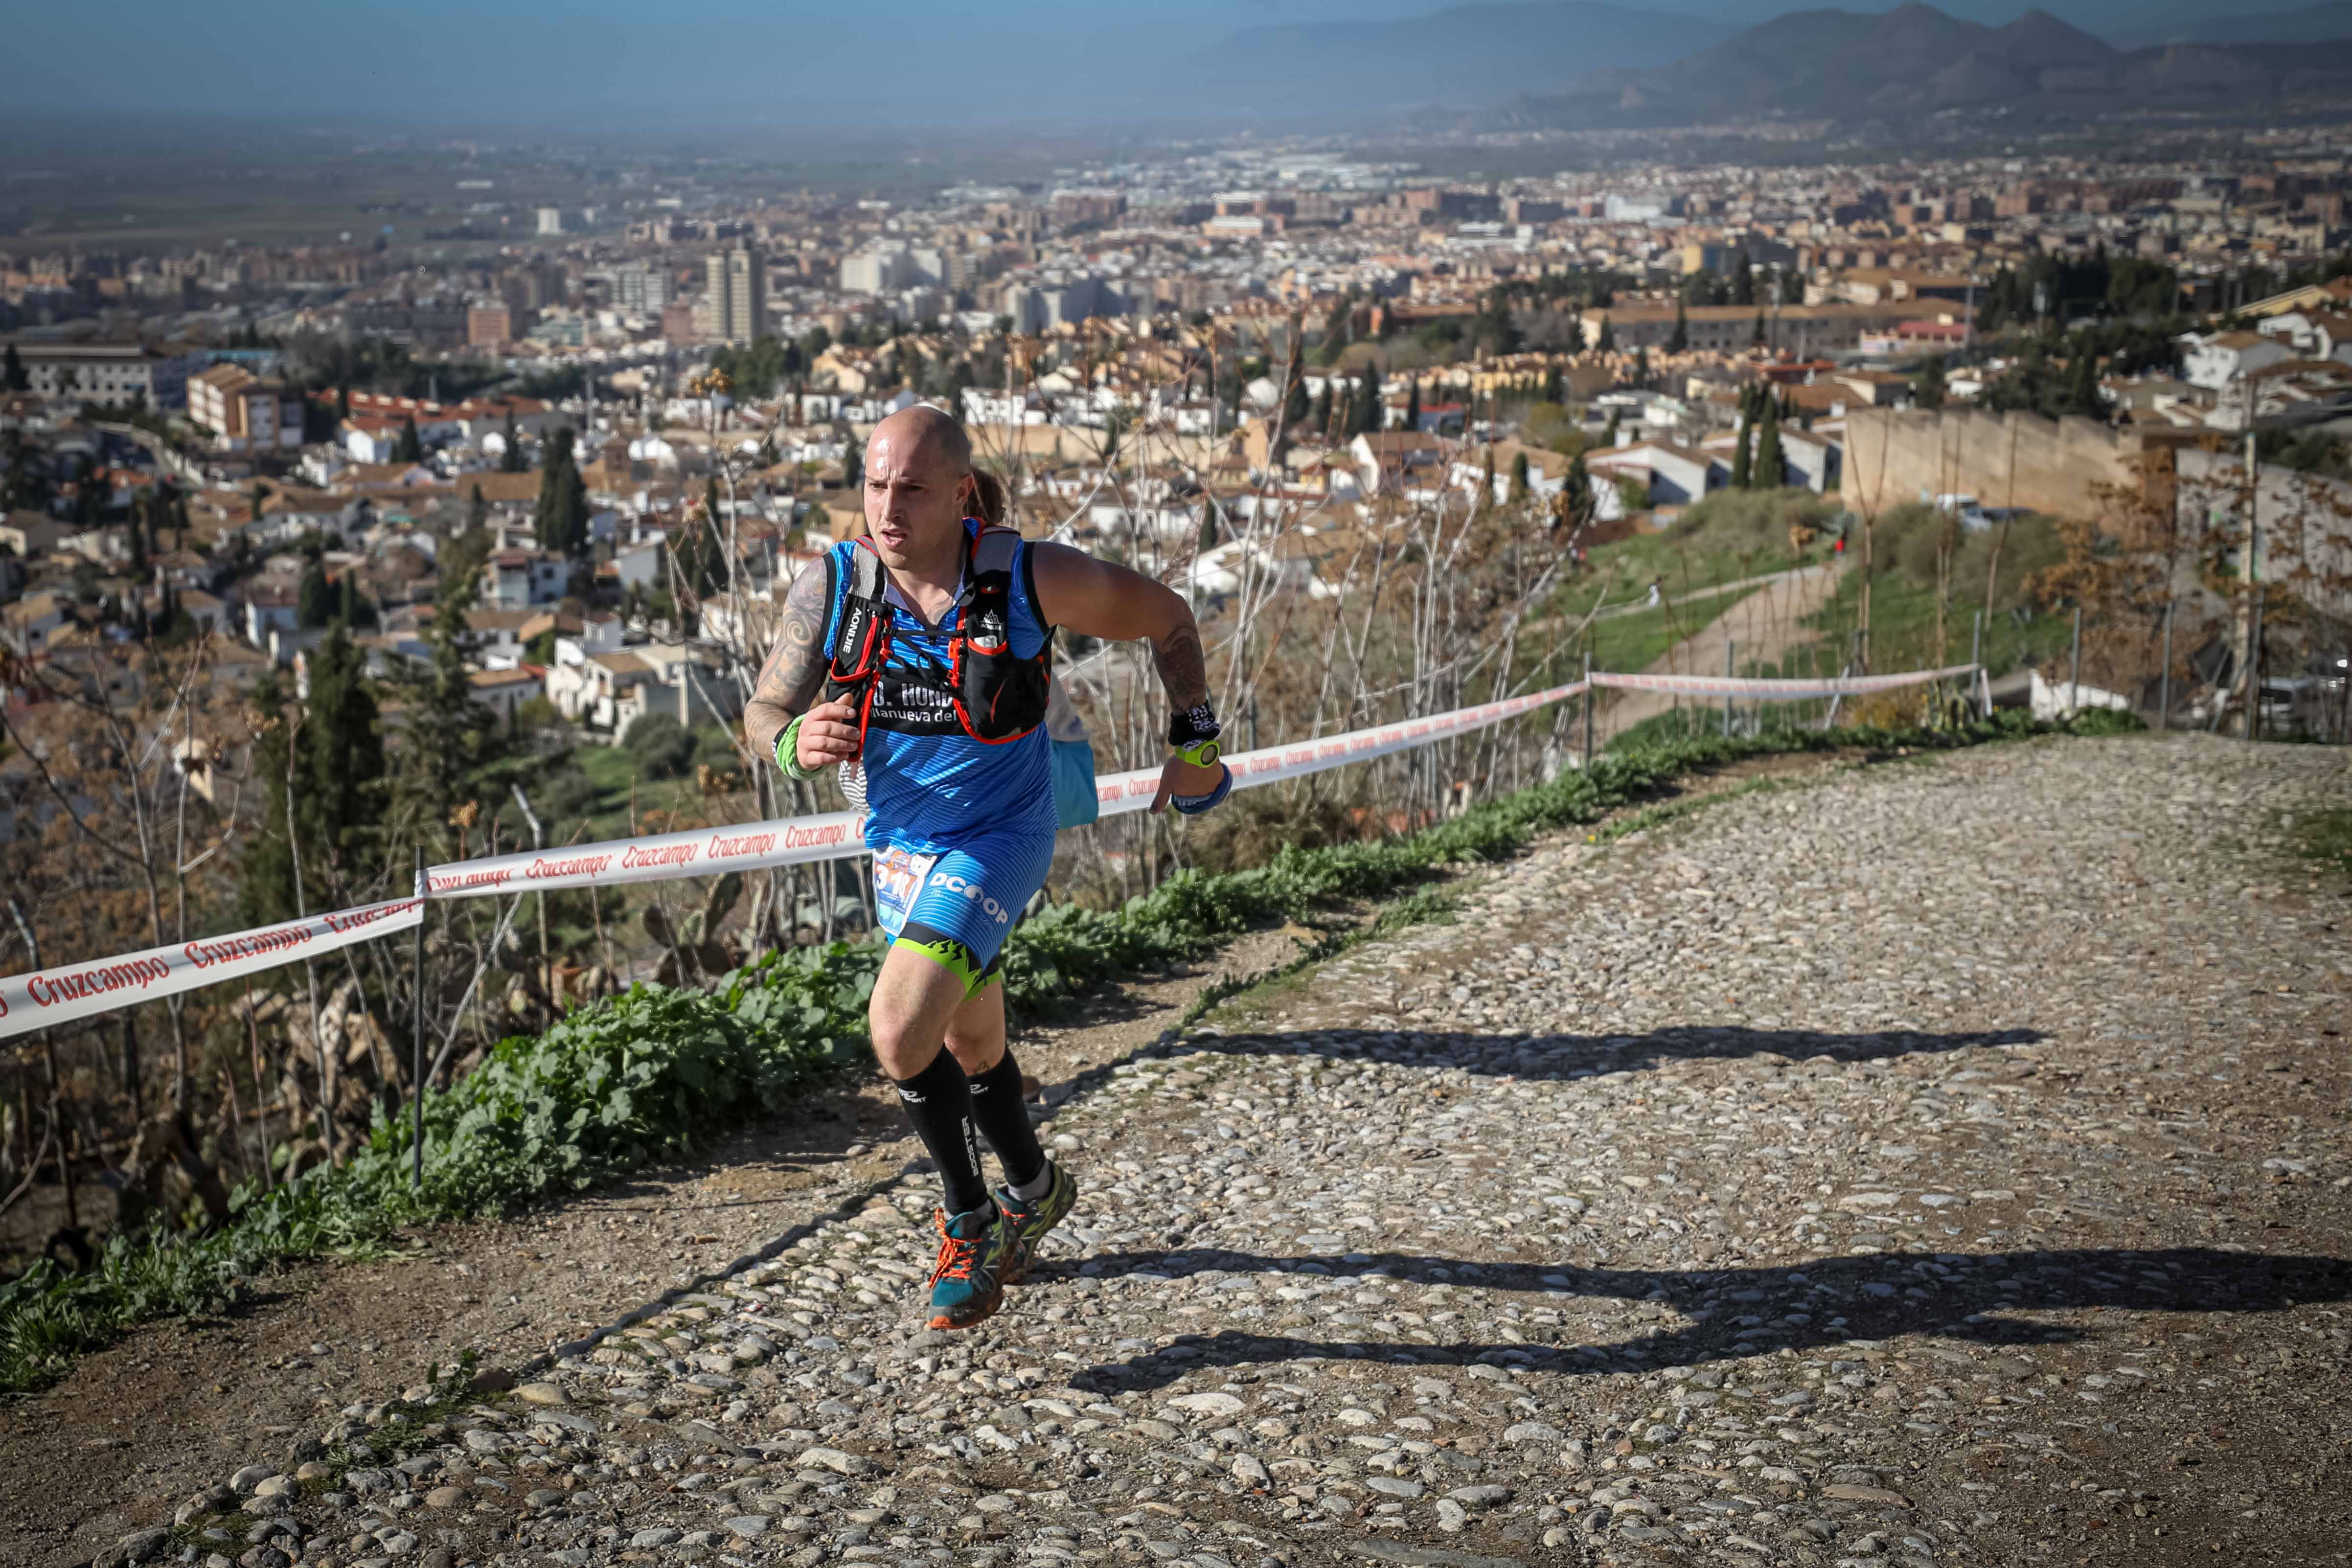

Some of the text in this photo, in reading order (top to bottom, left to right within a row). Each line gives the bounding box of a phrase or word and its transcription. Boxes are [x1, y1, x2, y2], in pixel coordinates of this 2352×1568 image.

[843, 607, 862, 654] AONIJIE
[870, 707, 957, 722] illanueva del
[1096, 785, 1123, 802] campo
[1129, 778, 1161, 797] Cruzcam
[622, 842, 700, 868] Cruzcampo
[708, 833, 776, 858] Cruzcampo
[785, 823, 847, 848] Cruzcampo
[27, 954, 170, 1007] Cruzcampo
[184, 924, 312, 969] Cruzcampo
[961, 1115, 979, 1177] BOOSTER
